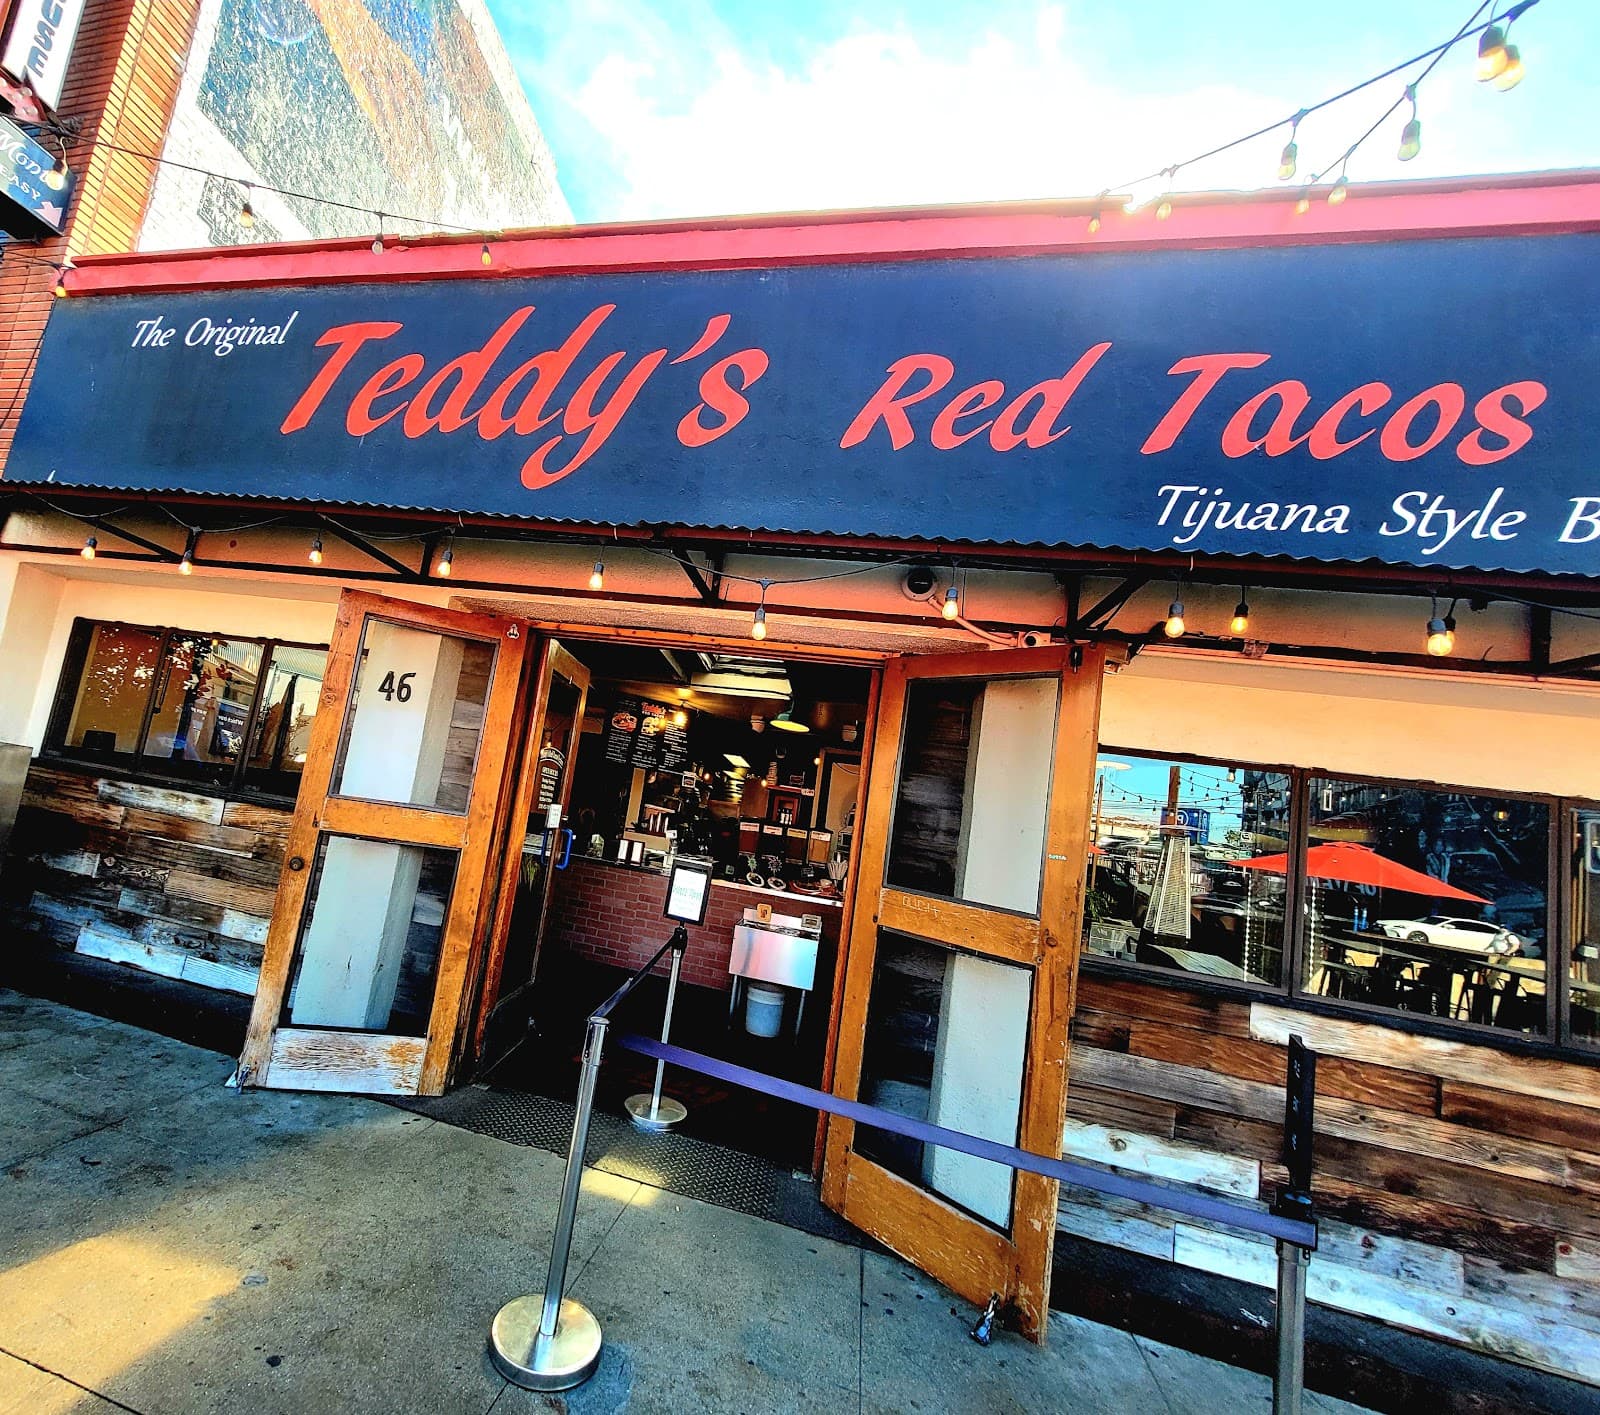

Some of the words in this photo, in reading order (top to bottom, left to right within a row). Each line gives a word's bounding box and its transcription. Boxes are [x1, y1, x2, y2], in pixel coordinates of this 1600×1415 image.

[27, 0, 66, 78] USE
[131, 317, 176, 348] The
[185, 310, 299, 357] Original
[281, 303, 768, 489] Teddy's
[841, 343, 1110, 451] Red
[1142, 354, 1546, 465] Tacos
[1157, 485, 1350, 544] Tijuana
[1379, 487, 1527, 555] Style
[378, 671, 416, 702] 46
